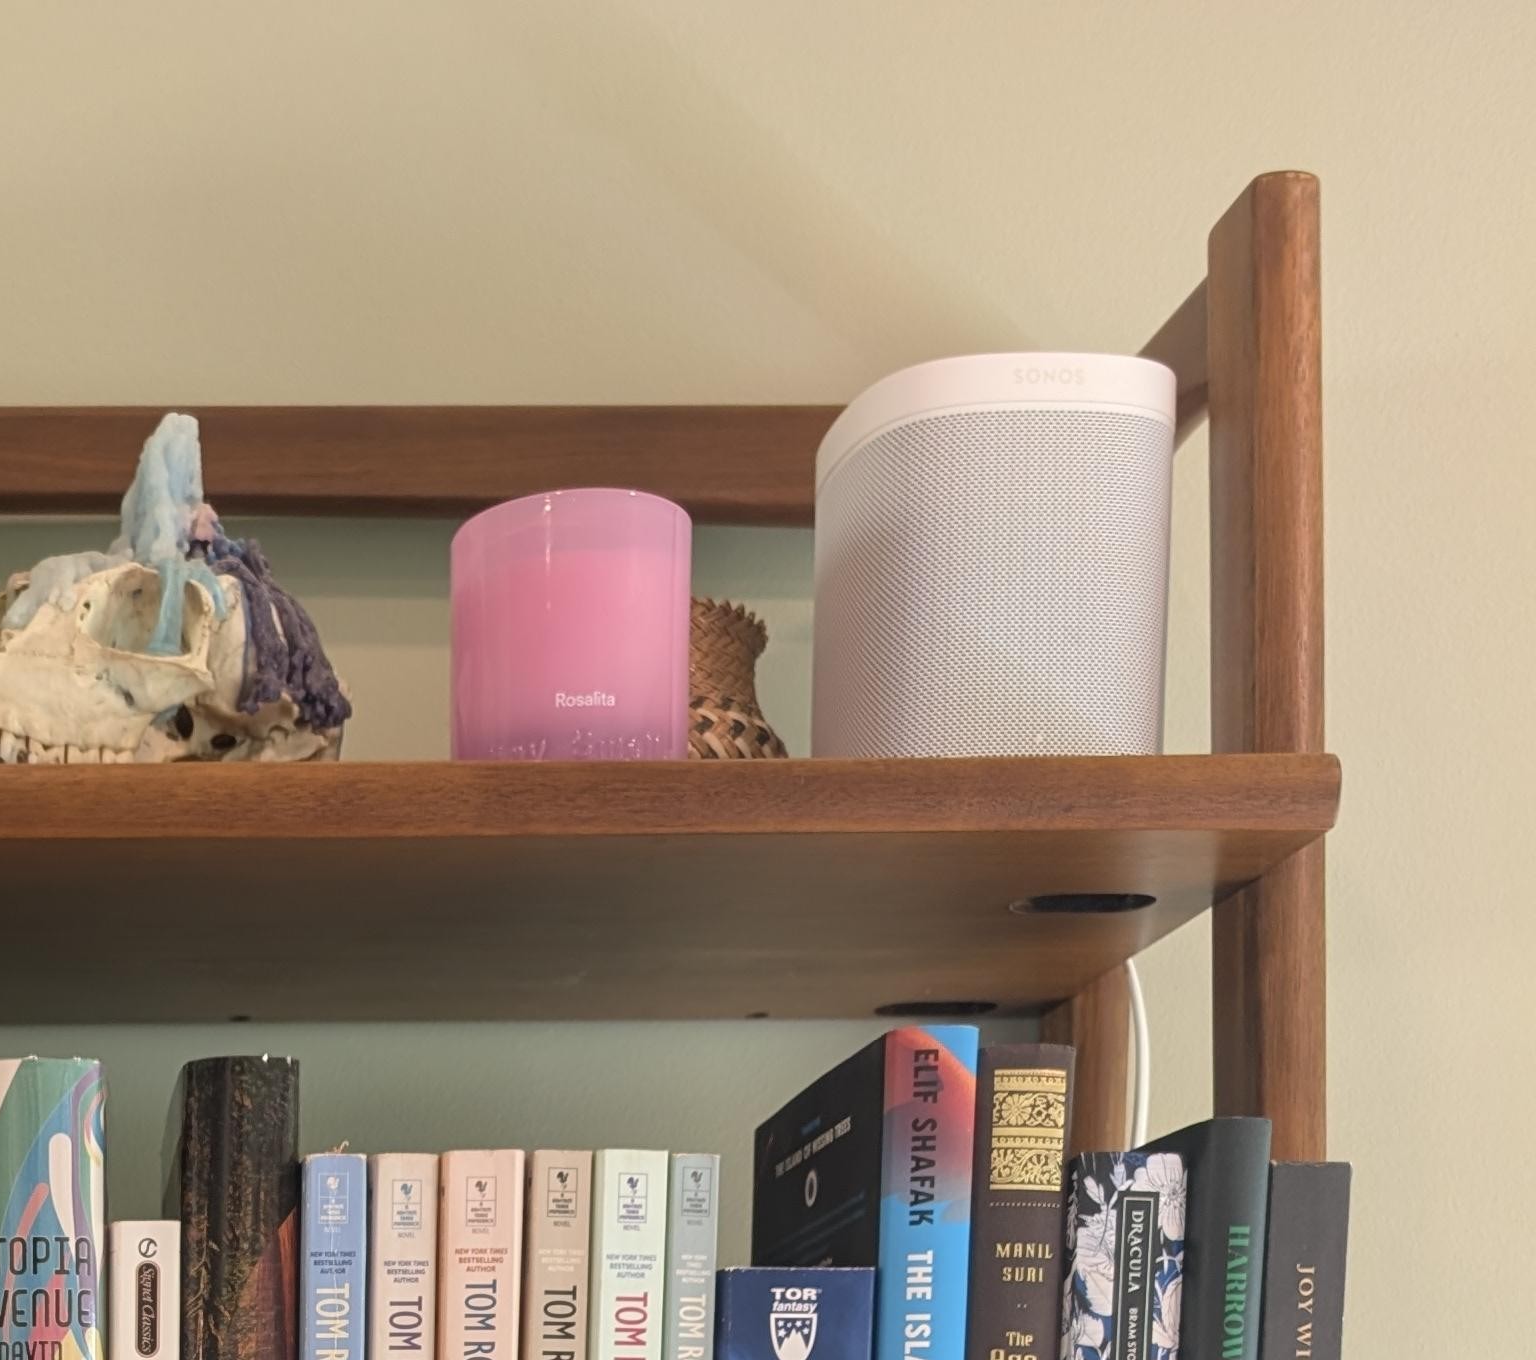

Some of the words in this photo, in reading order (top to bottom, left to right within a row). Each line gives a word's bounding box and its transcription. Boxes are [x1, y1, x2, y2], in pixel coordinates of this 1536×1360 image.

[1012, 368, 1086, 386] SONOS
[555, 692, 616, 708] Rosalita
[913, 1049, 939, 1104] ELIF
[909, 1118, 937, 1227] SHAFAK
[906, 1250, 933, 1301] THE
[1127, 1210, 1145, 1294] DRACULA
[315, 1283, 350, 1339] TOM
[1222, 1225, 1250, 1360] HARROW
